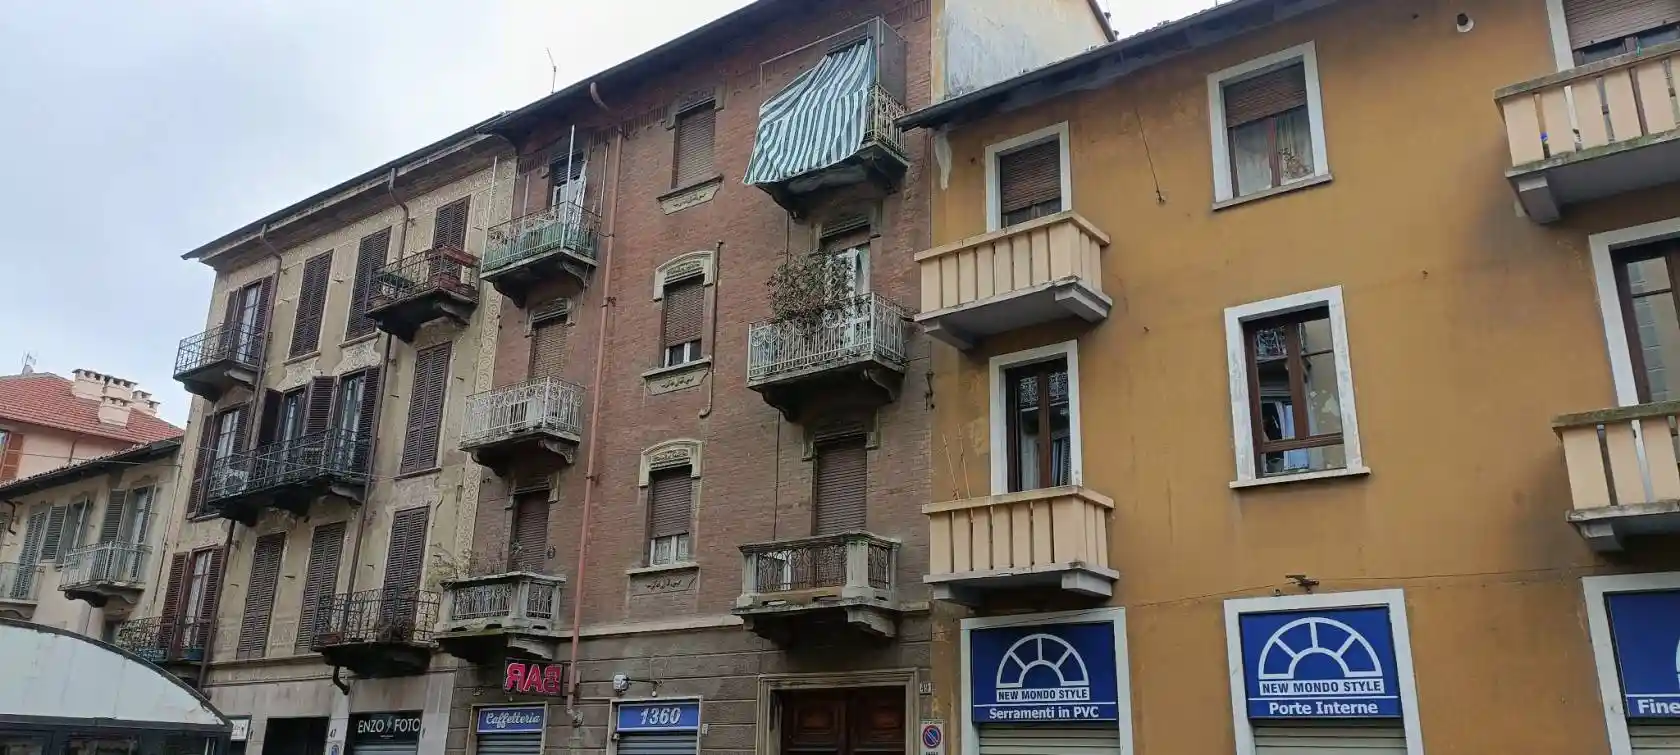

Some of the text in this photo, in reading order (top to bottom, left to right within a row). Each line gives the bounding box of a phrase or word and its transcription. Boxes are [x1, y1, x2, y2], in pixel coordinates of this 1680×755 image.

[998, 688, 1088, 700] NEW MONDO STYLE
[1262, 681, 1381, 693] NEW MONDO STYLE
[988, 706, 1099, 719] Serramenti in PVC
[1268, 701, 1379, 715] Porte Interne
[485, 711, 541, 728] Caffetteria
[640, 708, 681, 725] 1360
[358, 718, 420, 733] ENZO FOTO
